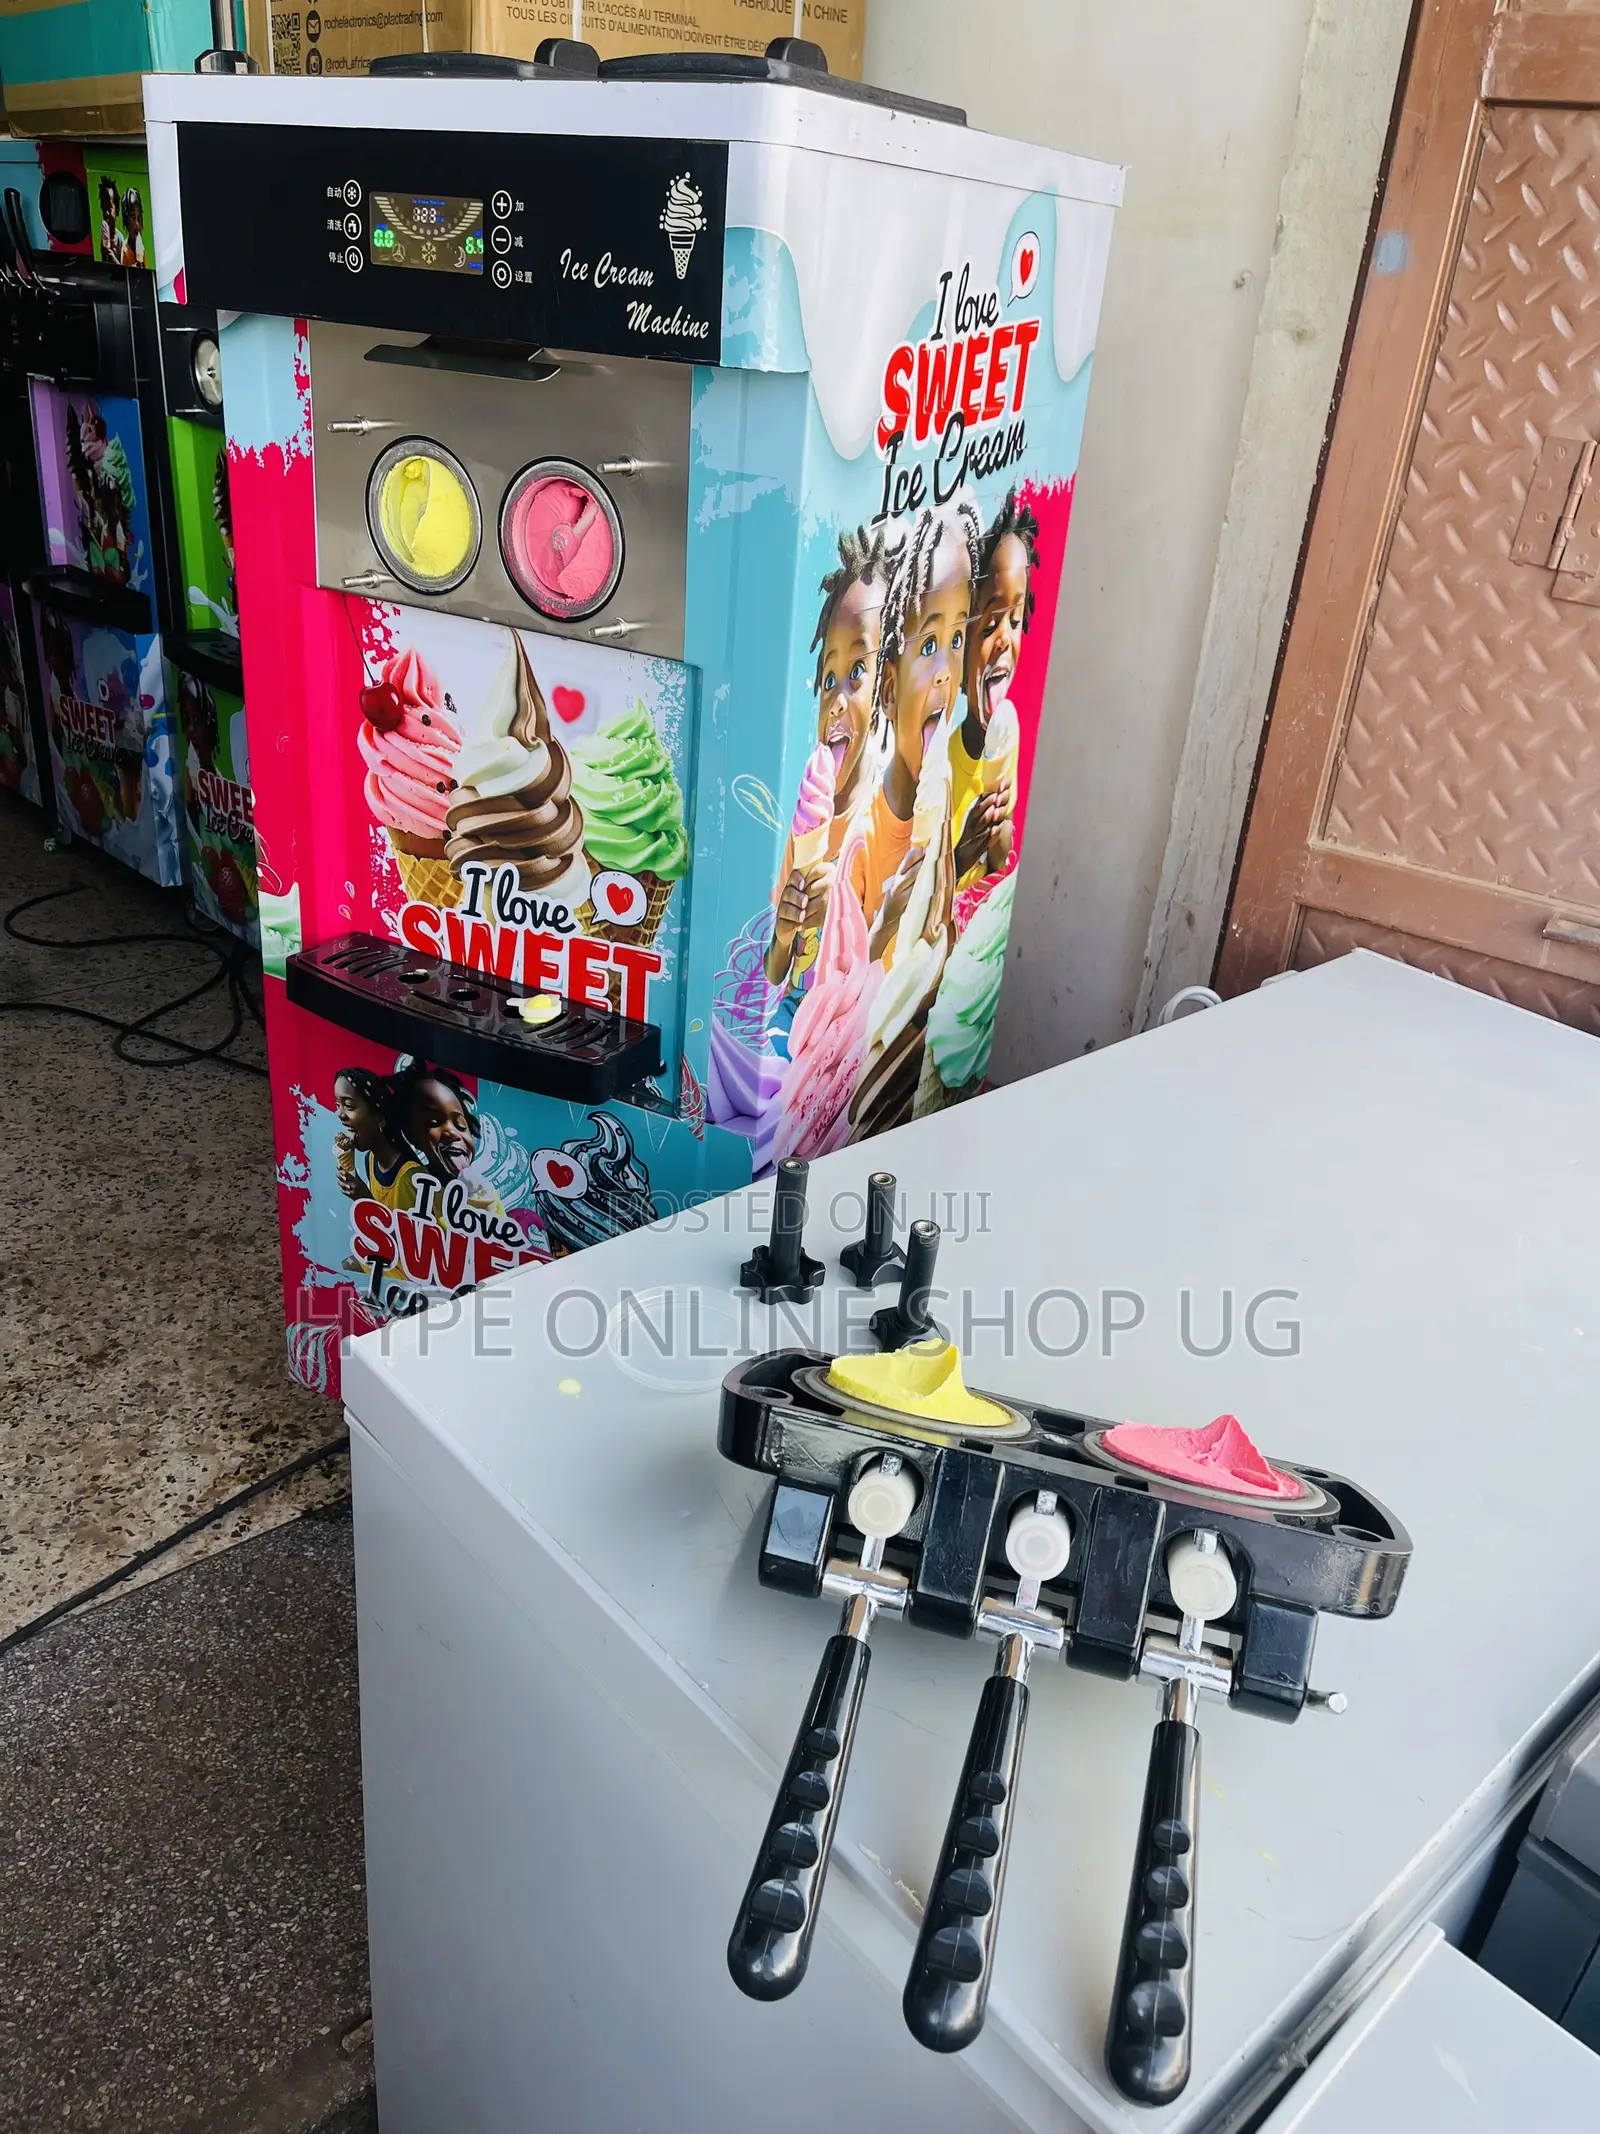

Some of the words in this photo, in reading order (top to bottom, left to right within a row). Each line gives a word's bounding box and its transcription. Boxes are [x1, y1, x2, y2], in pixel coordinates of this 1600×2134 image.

[506, 6, 536, 21] TOUS
[538, 10, 557, 24] LES
[608, 19, 683, 41] D'ALIMENTATION
[683, 29, 722, 45] DOIVENT
[724, 34, 746, 50] ÊTRE
[638, 8, 651, 21] AU
[813, 4, 849, 24] CHINE
[326, 186, 343, 199] 自动
[514, 199, 525, 212] 加
[326, 219, 343, 231] 清洗
[514, 235, 524, 248] 减
[328, 251, 345, 264] 停止
[514, 270, 533, 284] 设置
[560, 248, 588, 281] Ice
[593, 251, 655, 289] Cream
[626, 300, 710, 339] Machine
[931, 270, 953, 342] I
[954, 262, 999, 335] love
[877, 319, 1041, 451] SWEET
[869, 429, 928, 529] Ice
[933, 410, 1028, 506] Cream
[59, 694, 116, 745] SWEET
[460, 866, 487, 919] I
[496, 868, 576, 934] love
[411, 1177, 438, 1222] I
[446, 1183, 526, 1248] love
